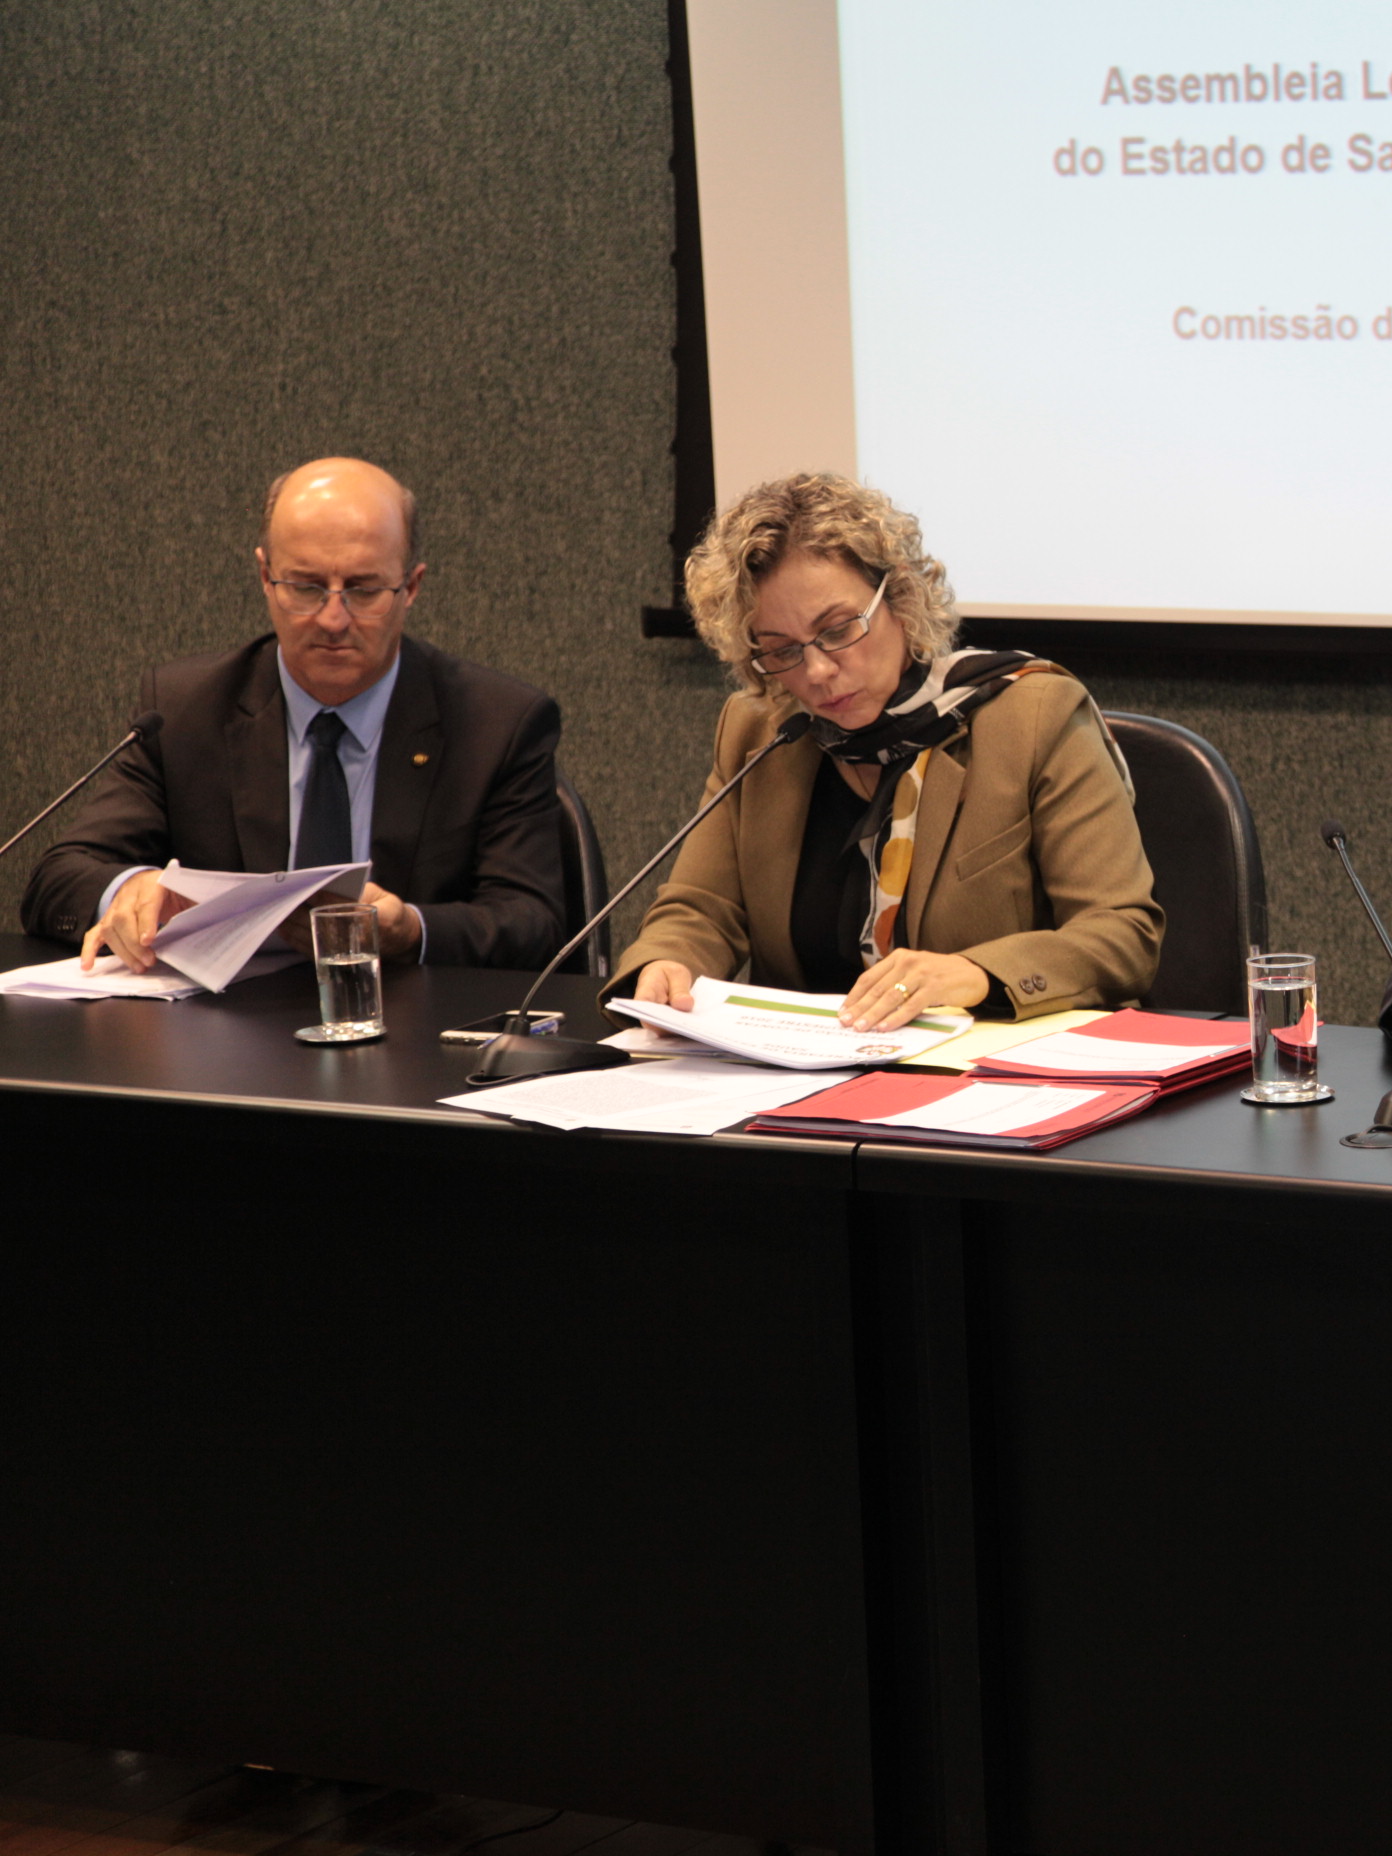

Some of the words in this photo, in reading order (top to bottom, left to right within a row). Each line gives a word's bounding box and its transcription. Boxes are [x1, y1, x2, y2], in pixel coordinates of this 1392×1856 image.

[1101, 62, 1344, 104] Assembleia
[1054, 138, 1105, 176] do
[1121, 136, 1265, 175] Estado
[1282, 134, 1332, 173] de
[1172, 304, 1359, 340] Comissão
